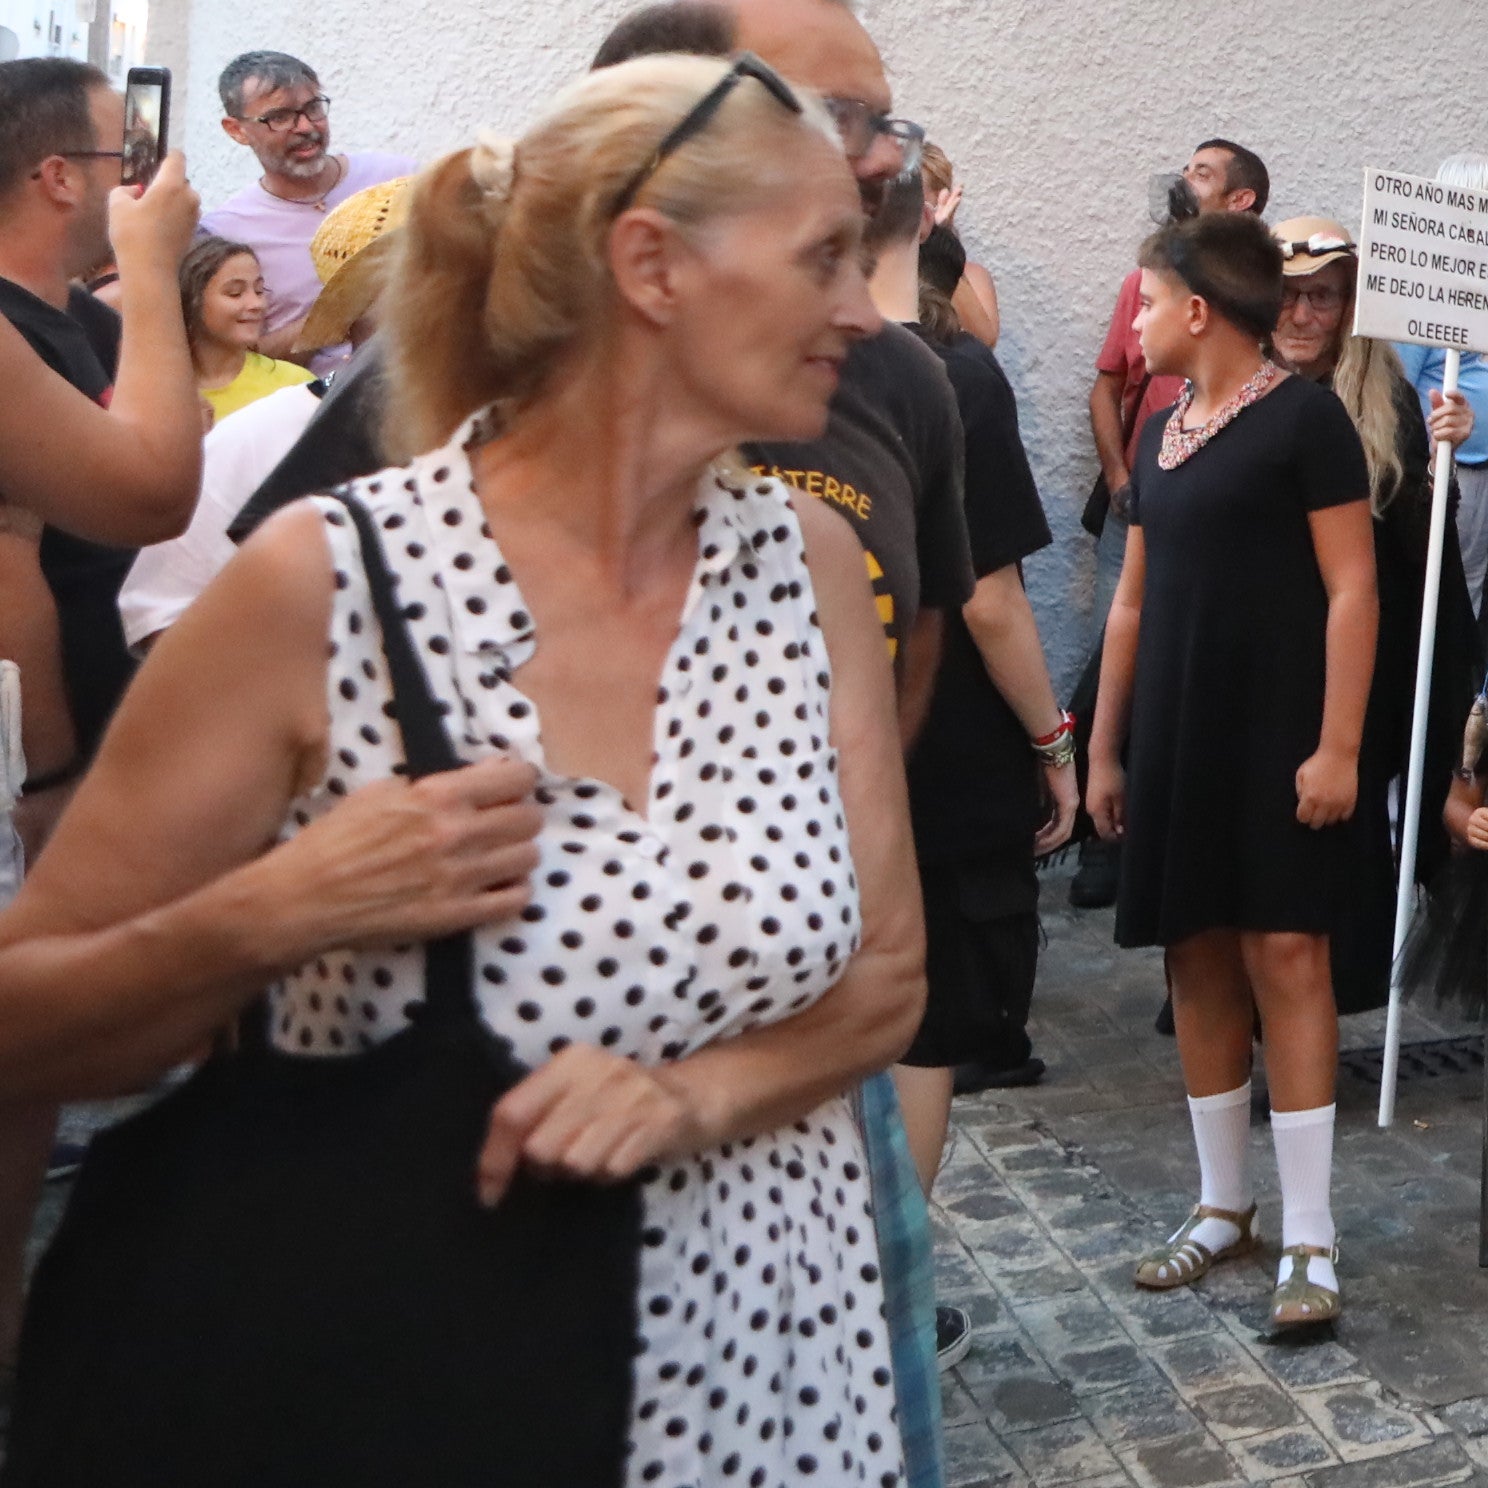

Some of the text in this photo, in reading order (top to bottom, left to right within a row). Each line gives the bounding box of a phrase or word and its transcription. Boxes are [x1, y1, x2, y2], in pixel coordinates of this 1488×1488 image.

[1375, 175, 1412, 198] OTRO
[1415, 182, 1444, 204] AÑO
[1447, 190, 1475, 212] MAS
[1373, 208, 1388, 226] MI
[1391, 211, 1445, 238] SEÑORA
[1370, 242, 1407, 264] PERO
[1410, 250, 1428, 268] LO
[1431, 254, 1475, 277] MEJOR
[1366, 274, 1386, 293] ME
[1390, 278, 1425, 302] DEJO
[1428, 287, 1445, 304] LA
[1408, 319, 1469, 345] OLEEEEE
